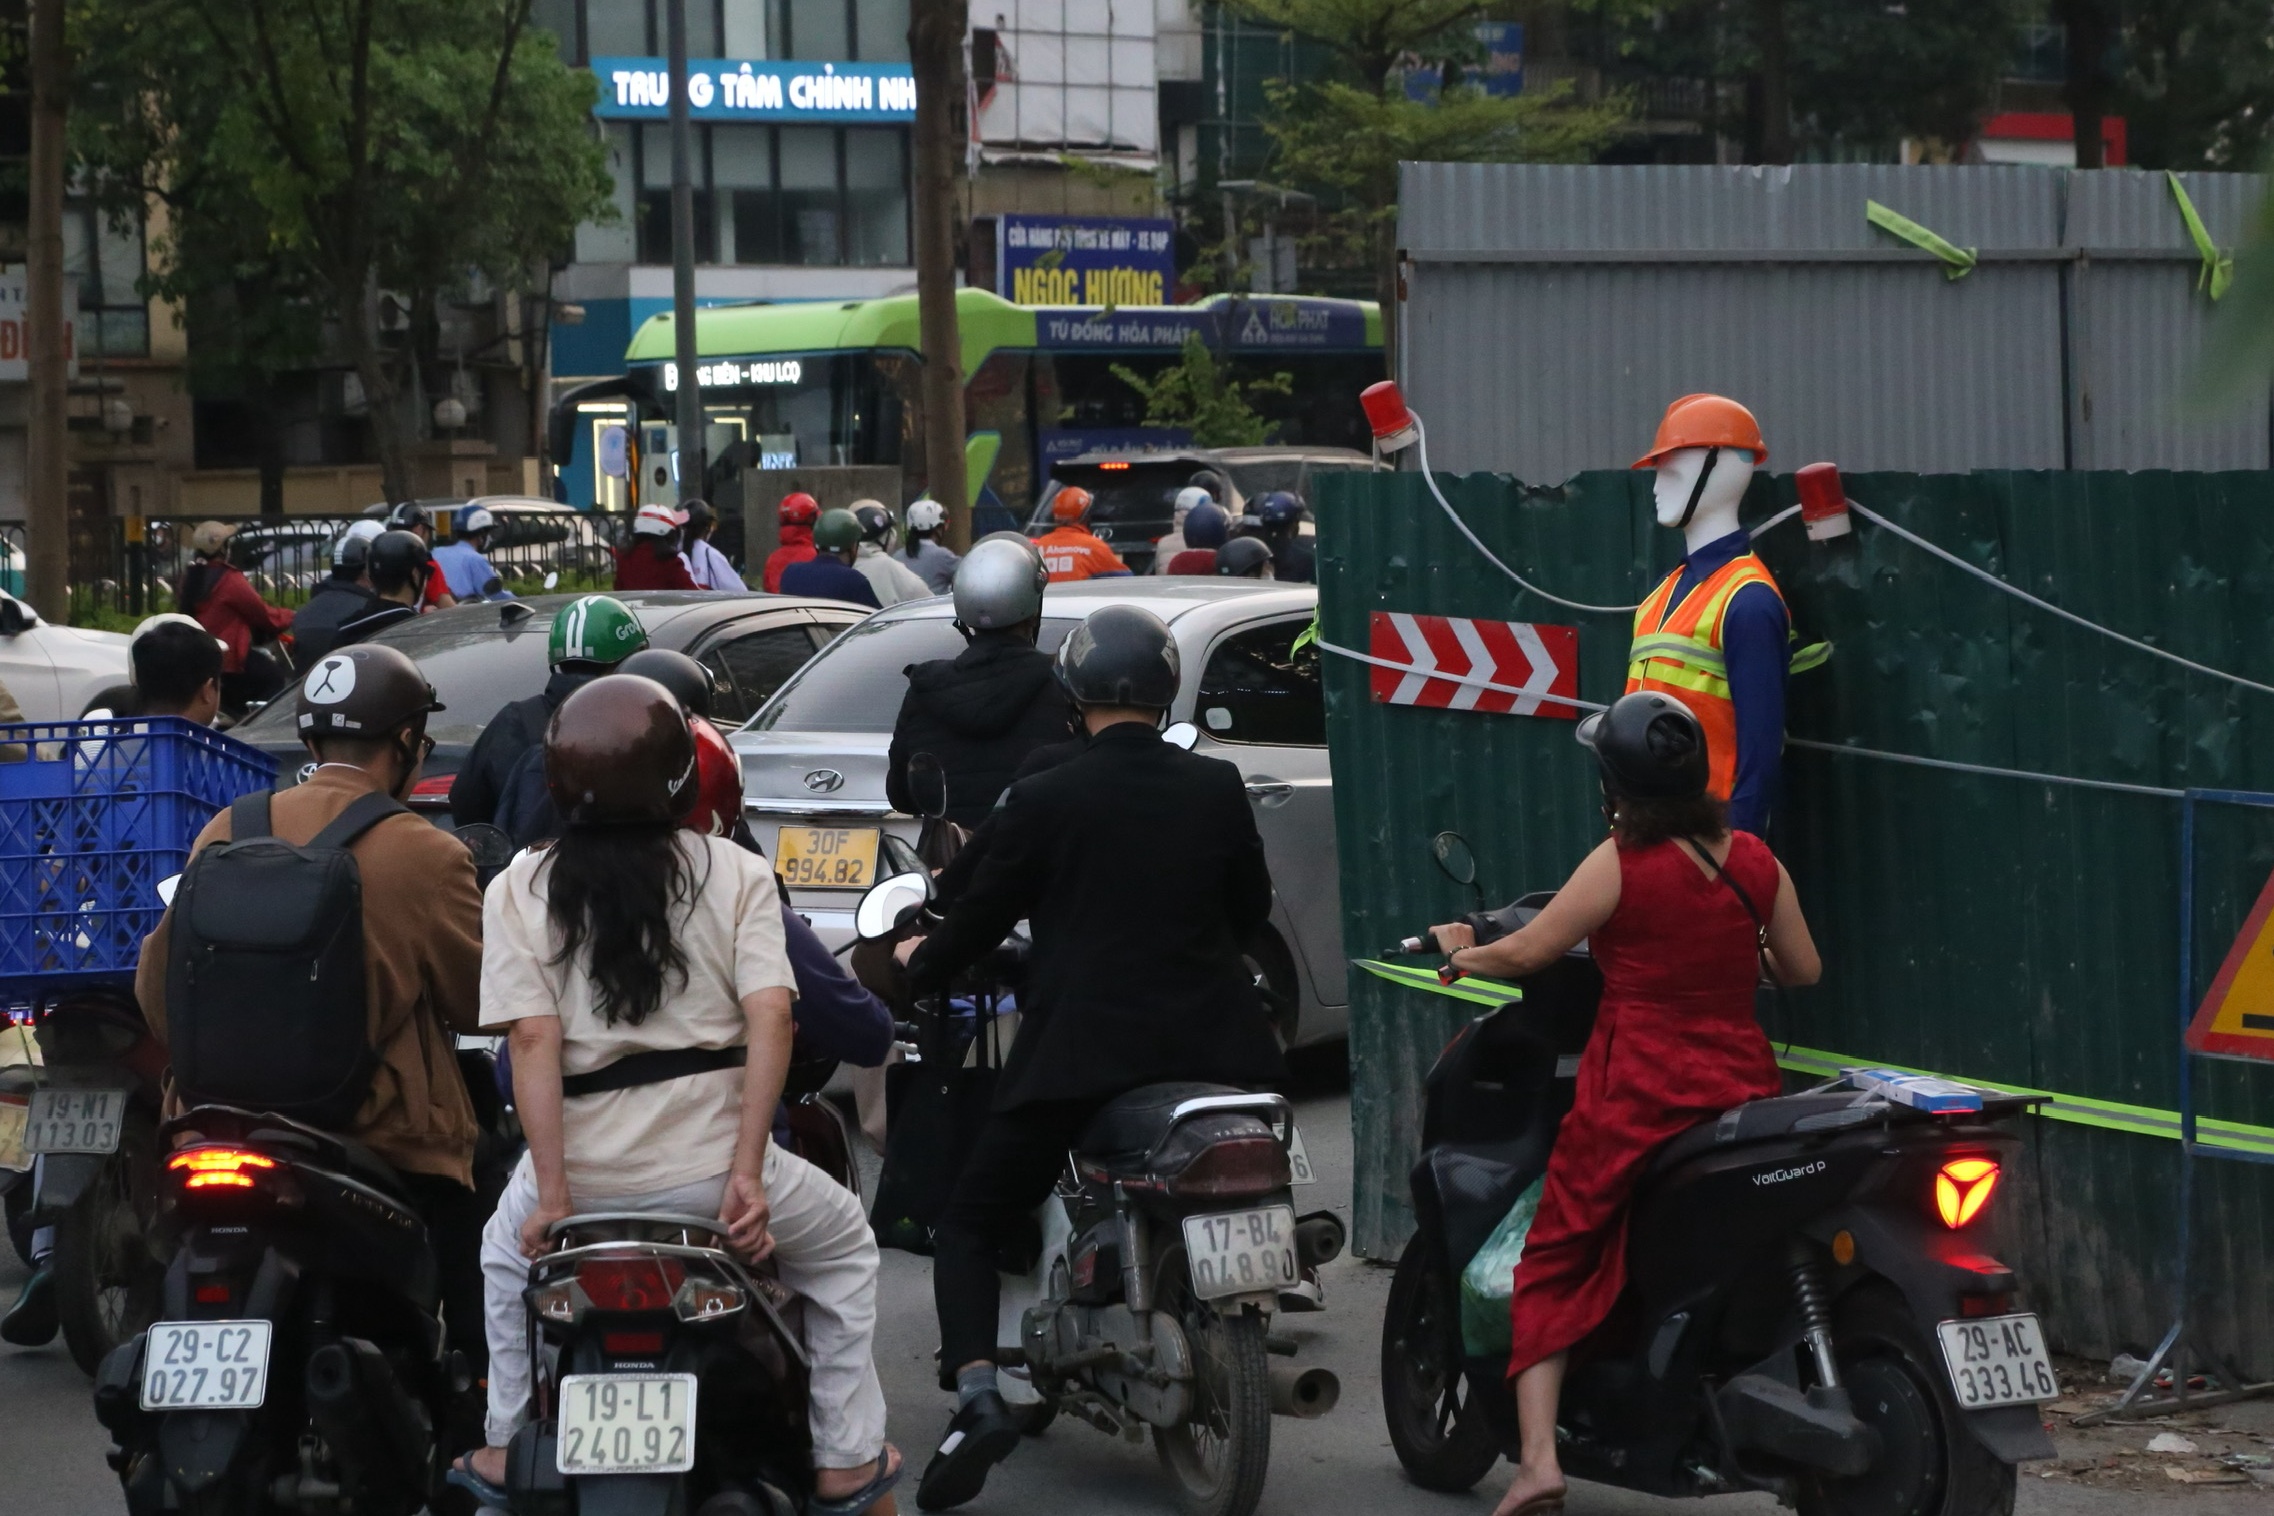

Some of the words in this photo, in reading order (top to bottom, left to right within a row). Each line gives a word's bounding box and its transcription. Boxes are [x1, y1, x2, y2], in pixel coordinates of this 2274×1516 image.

[612, 71, 714, 107] TRUG
[720, 62, 783, 109] TÂM
[806, 830, 851, 855] 30F
[784, 857, 864, 884] 994.82
[46, 1093, 109, 1120] 19-N1
[32, 1122, 114, 1149] 113.03
[211, 1226, 248, 1234] HONDA
[1202, 1212, 1281, 1253] 17-B4
[164, 1328, 252, 1365] 29-C2
[1957, 1321, 2033, 1362] 29-AC
[149, 1367, 258, 1404] 027.97
[1960, 1360, 2052, 1403] 333.46
[585, 1381, 672, 1422] 19-L1
[566, 1425, 685, 1465] 240.92
